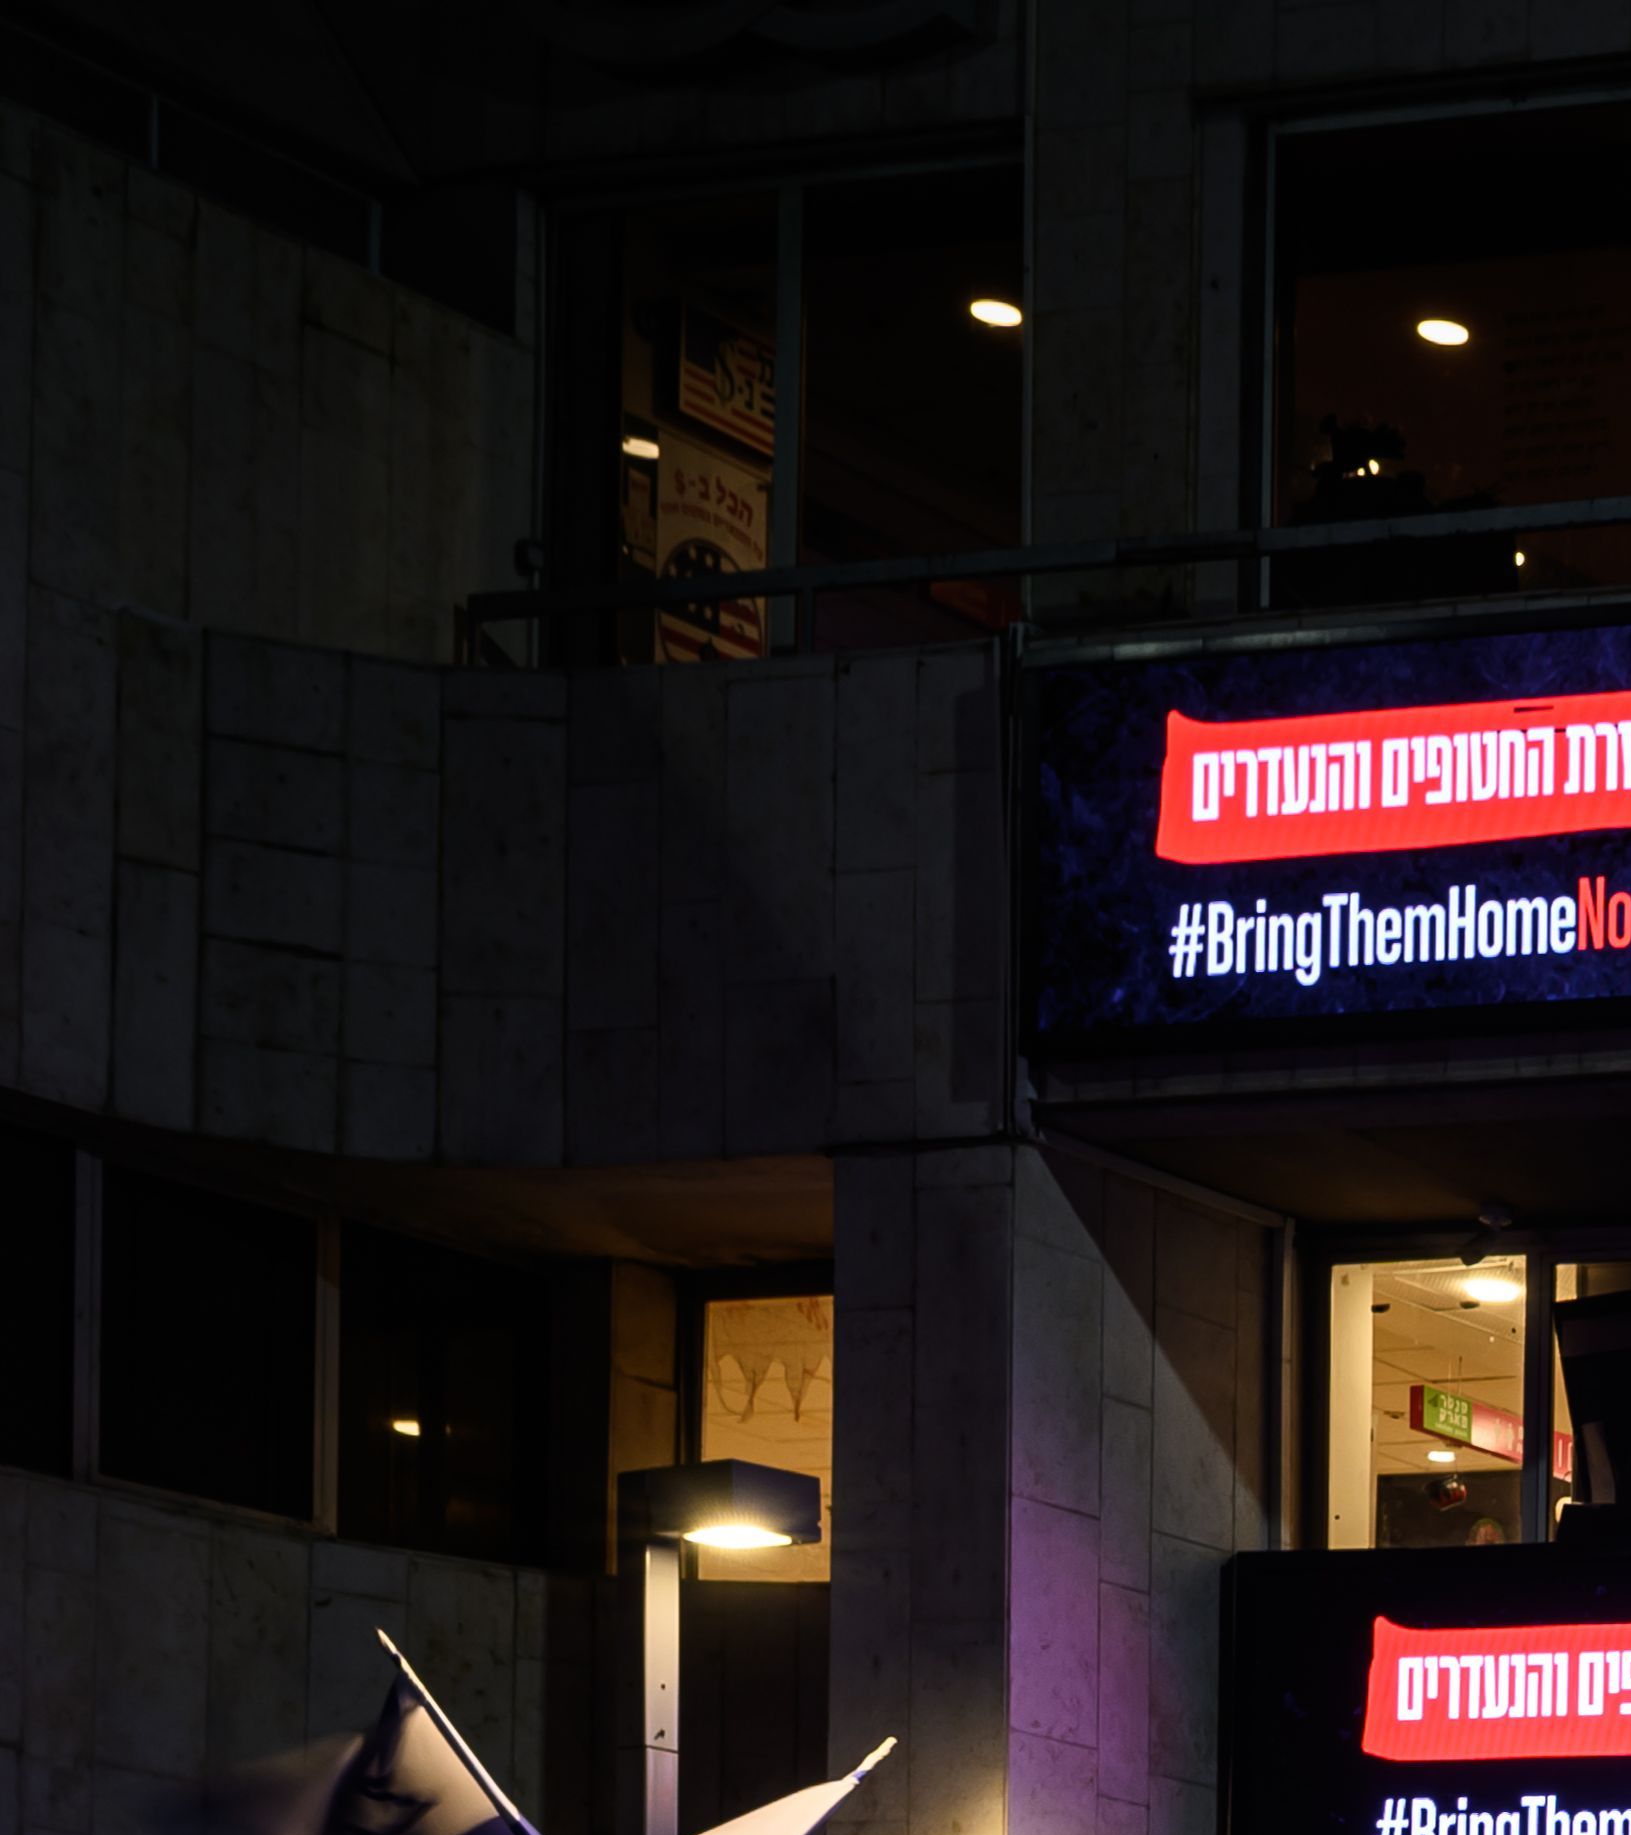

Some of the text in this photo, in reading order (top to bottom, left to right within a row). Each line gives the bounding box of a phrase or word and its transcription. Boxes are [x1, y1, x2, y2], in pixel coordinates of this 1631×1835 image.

[1191, 740, 1371, 822] והנעדרים
[1381, 728, 1554, 808] החטופים
[1396, 1652, 1569, 1721] והנעדרים
